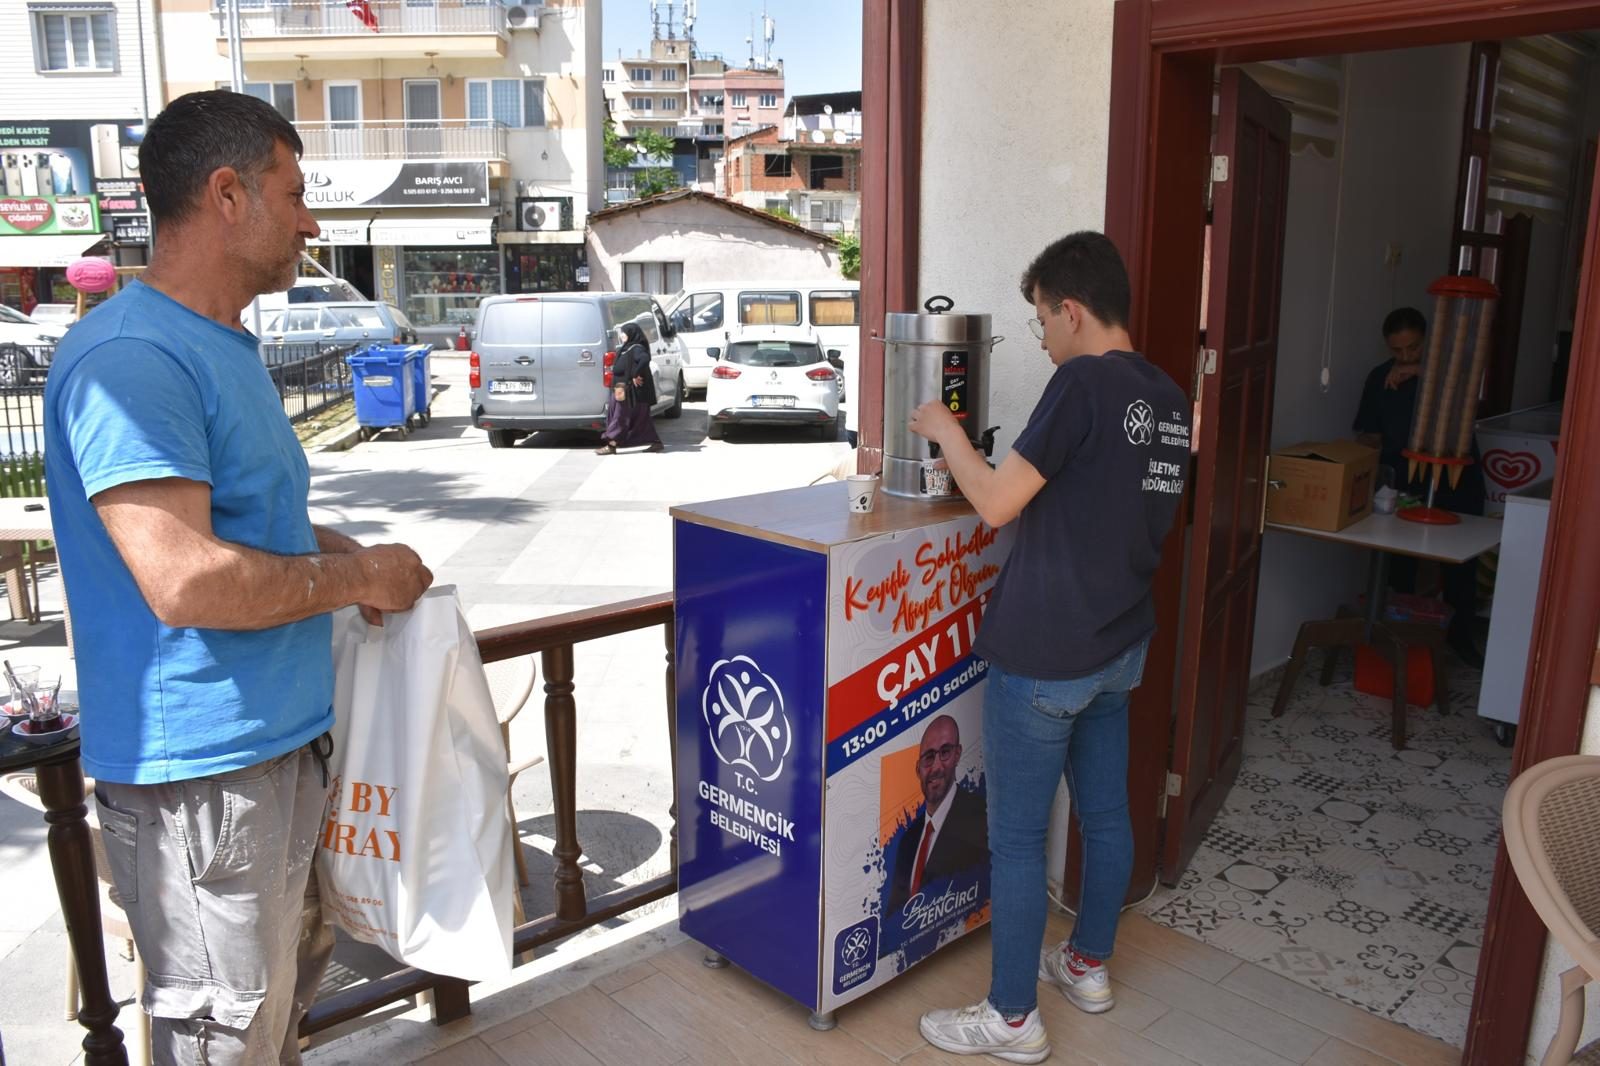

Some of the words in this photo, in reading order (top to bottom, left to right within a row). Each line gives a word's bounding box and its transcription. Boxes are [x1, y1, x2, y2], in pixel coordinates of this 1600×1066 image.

[21, 136, 48, 146] TAKSİT
[415, 177, 442, 186] BARIŞ
[443, 176, 463, 185] AVCI
[1148, 458, 1181, 477] İŞLETME
[845, 559, 910, 621] Keyifli
[892, 580, 944, 633] Afiyet
[877, 634, 940, 710] ÇAY
[947, 622, 961, 658] 1
[842, 720, 887, 758] 13:00
[901, 687, 941, 721] 17:00
[347, 782, 399, 816] BY
[734, 772, 758, 795] T.C.
[699, 780, 795, 842] GERMENCİK
[710, 810, 781, 857] BELEDİYESİ
[320, 810, 400, 862] İRAY
[919, 881, 979, 929] ZENCİRCİ
[840, 962, 871, 983] GERMENCİK
